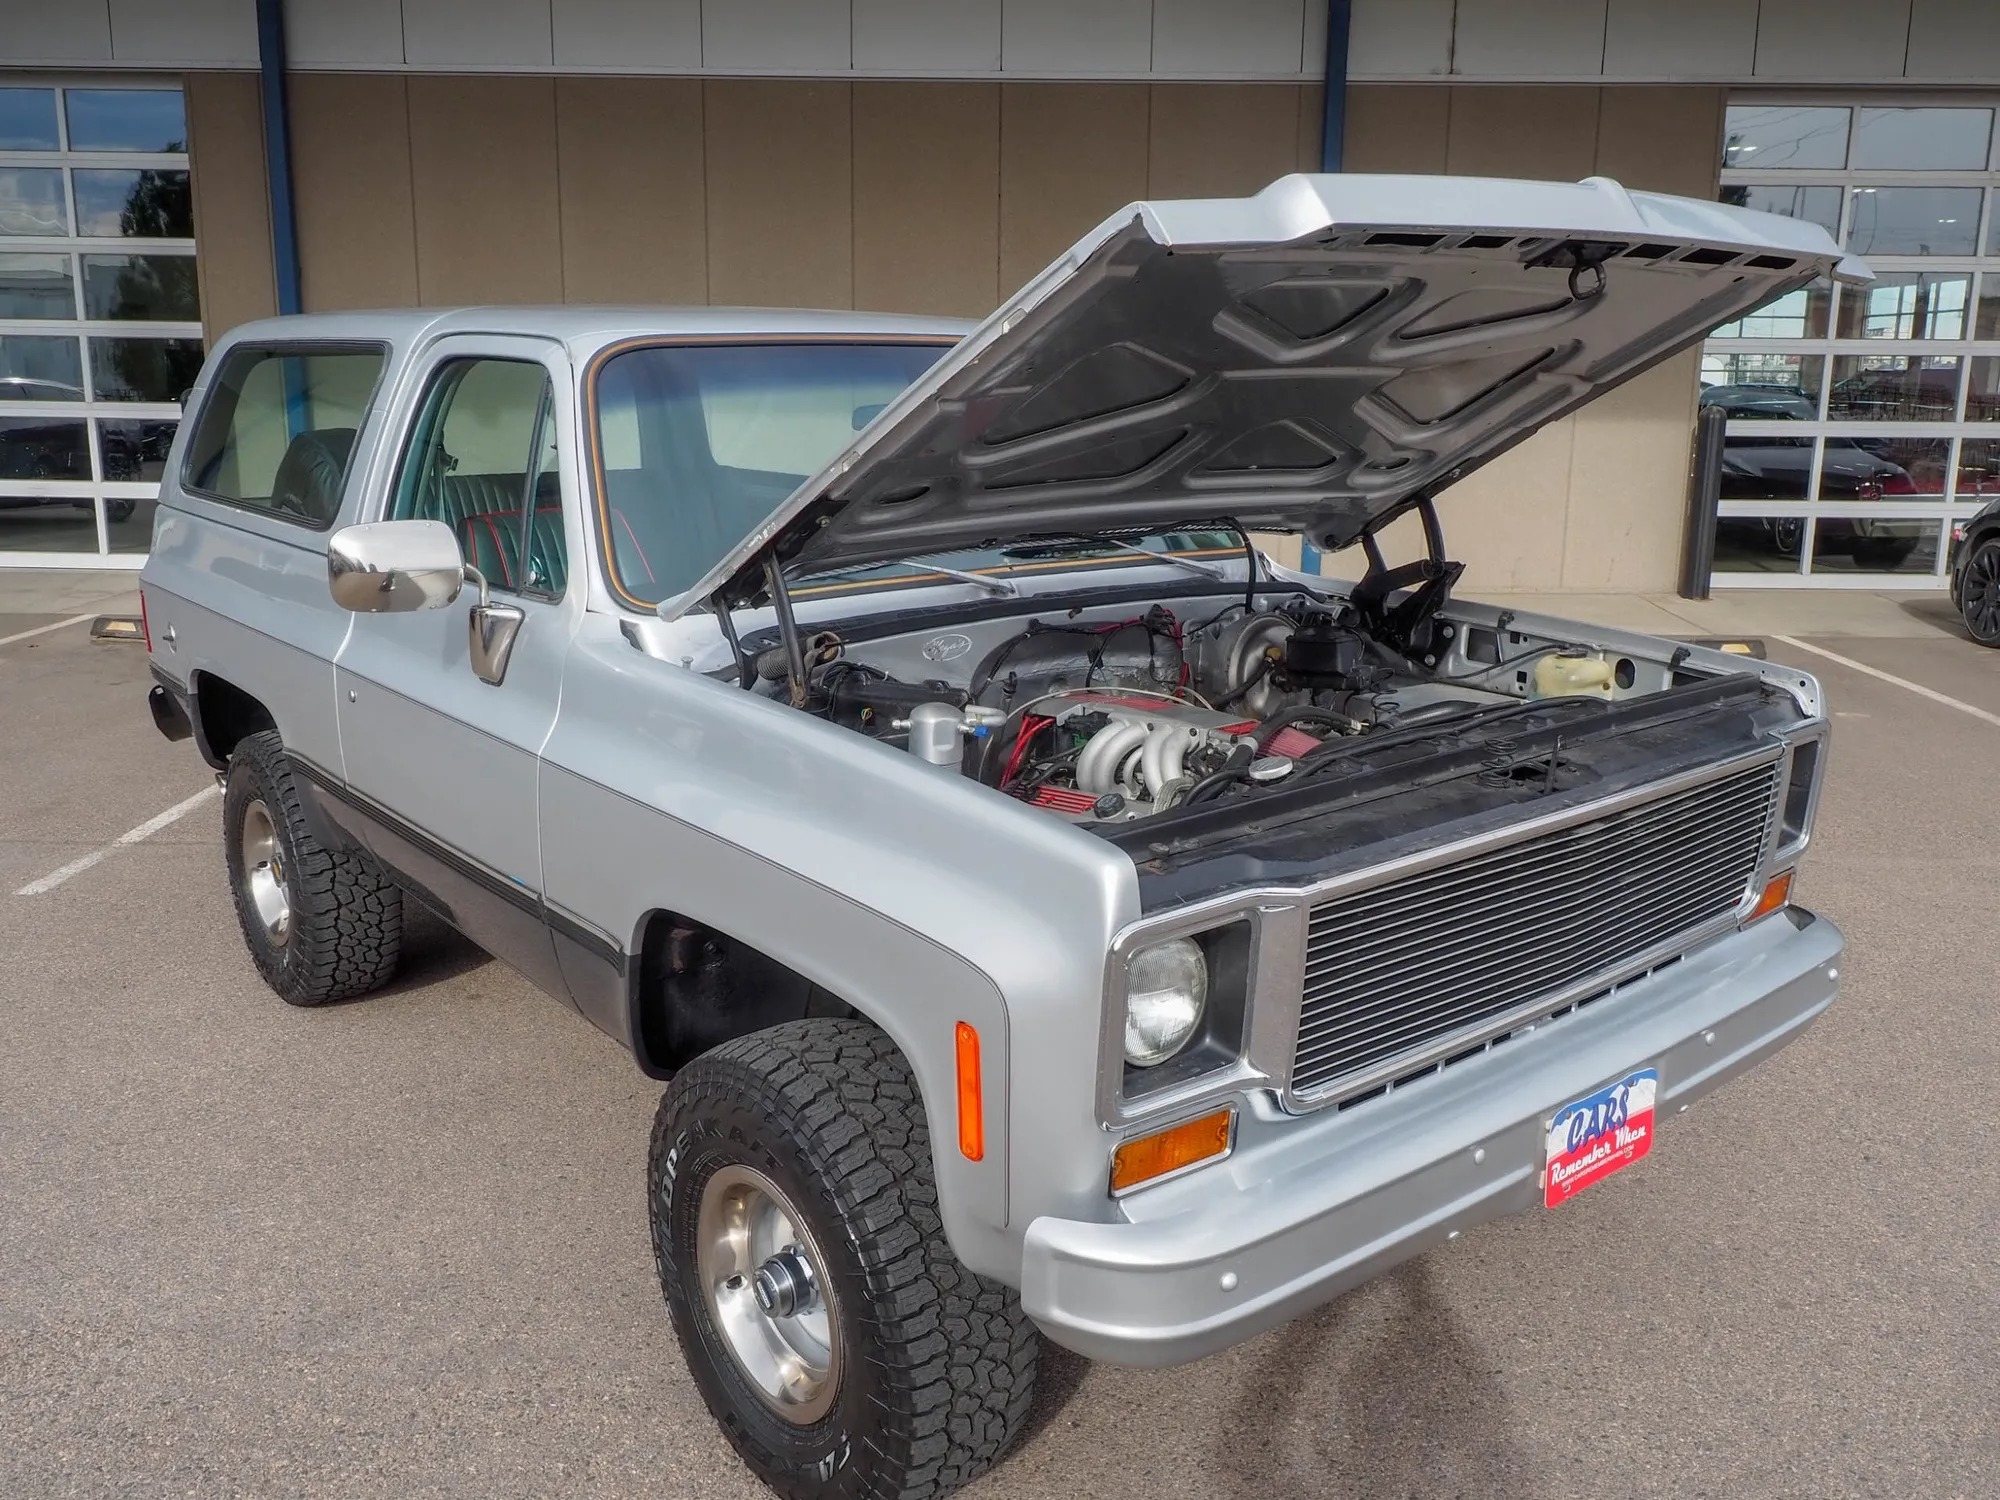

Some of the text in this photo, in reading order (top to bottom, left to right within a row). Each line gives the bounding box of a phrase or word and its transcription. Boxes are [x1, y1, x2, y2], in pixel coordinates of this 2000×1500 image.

[1567, 1086, 1629, 1153] CARS
[1551, 1125, 1647, 1186] Remember When
